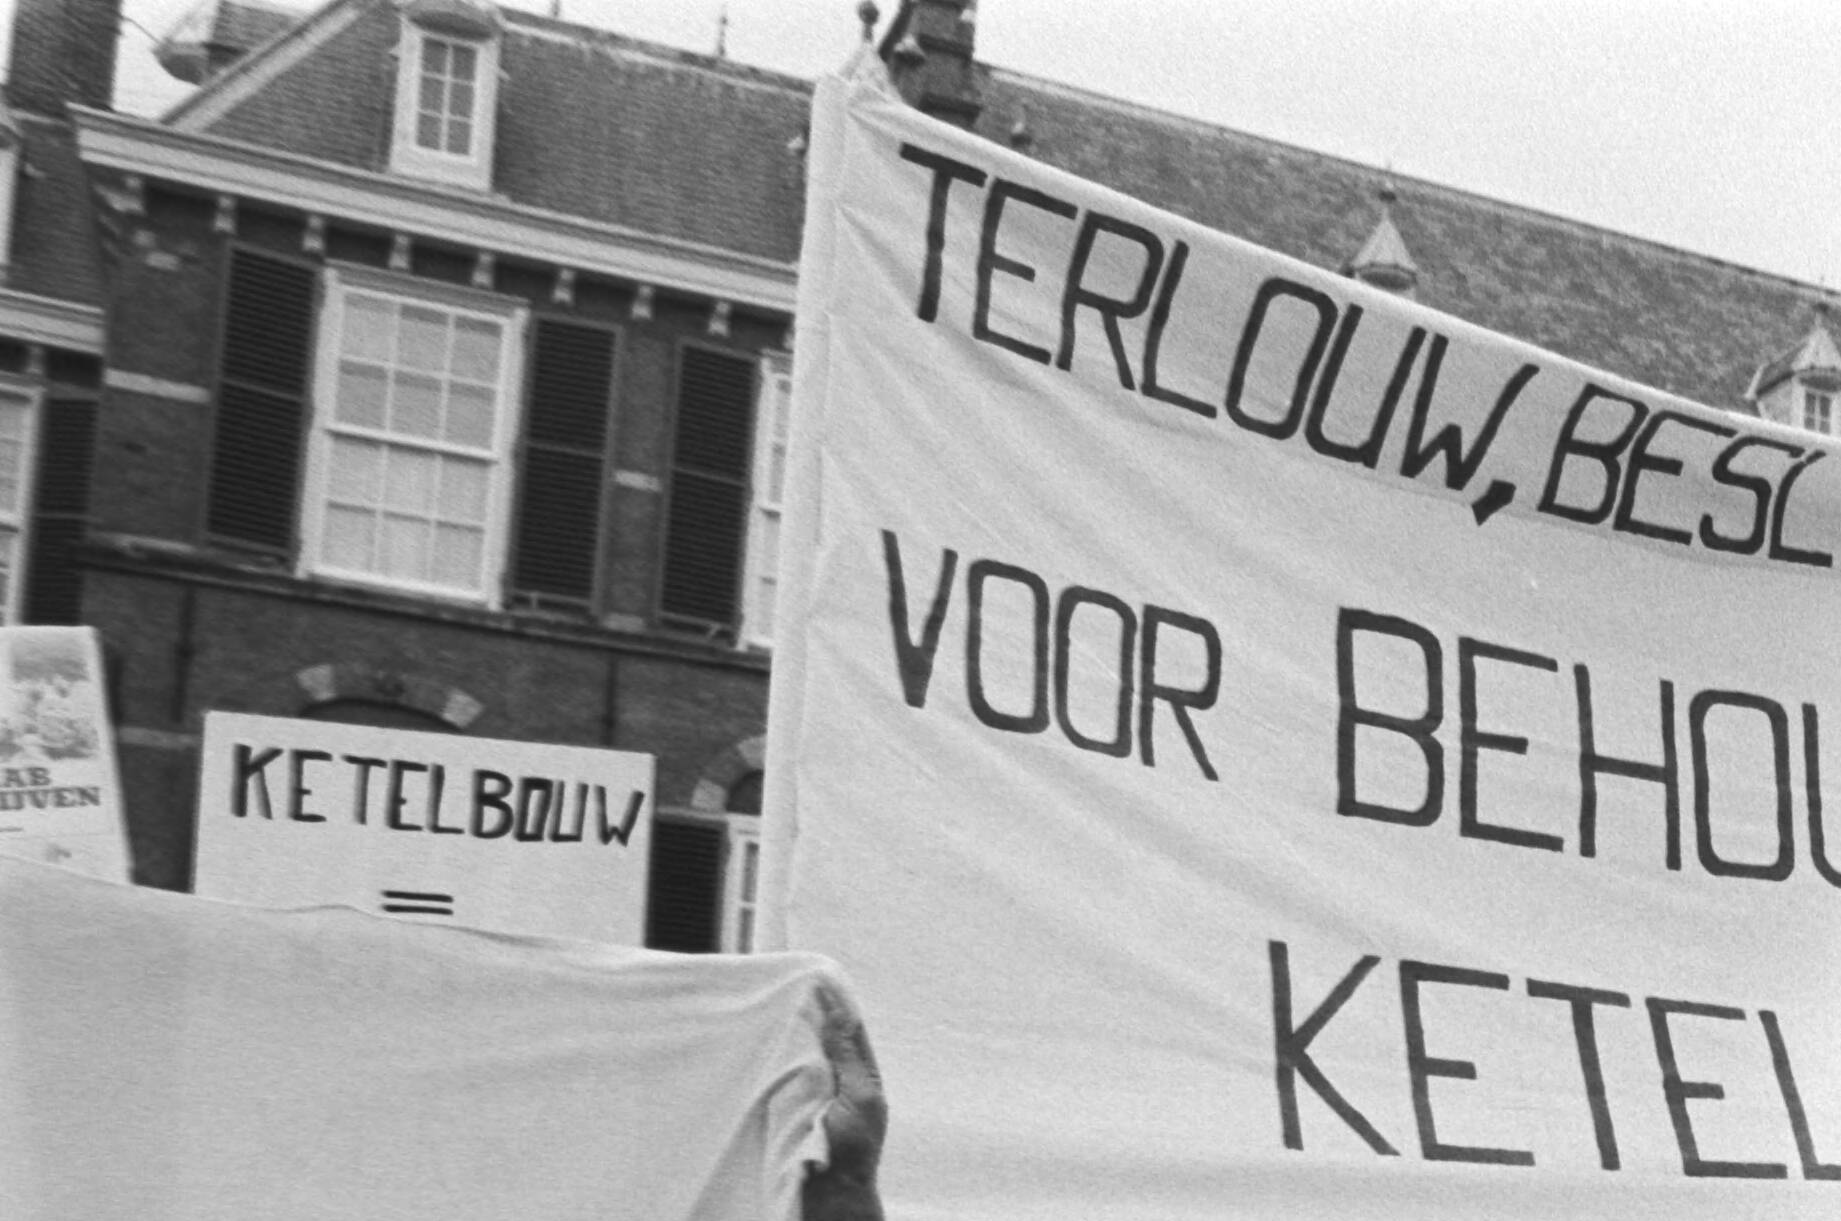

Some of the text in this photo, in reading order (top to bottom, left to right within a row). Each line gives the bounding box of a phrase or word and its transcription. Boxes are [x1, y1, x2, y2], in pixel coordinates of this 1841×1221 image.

[900, 141, 1541, 526] TERLOUW,
[880, 528, 1222, 782] VOOR
[230, 742, 645, 848] KETELBOUW
